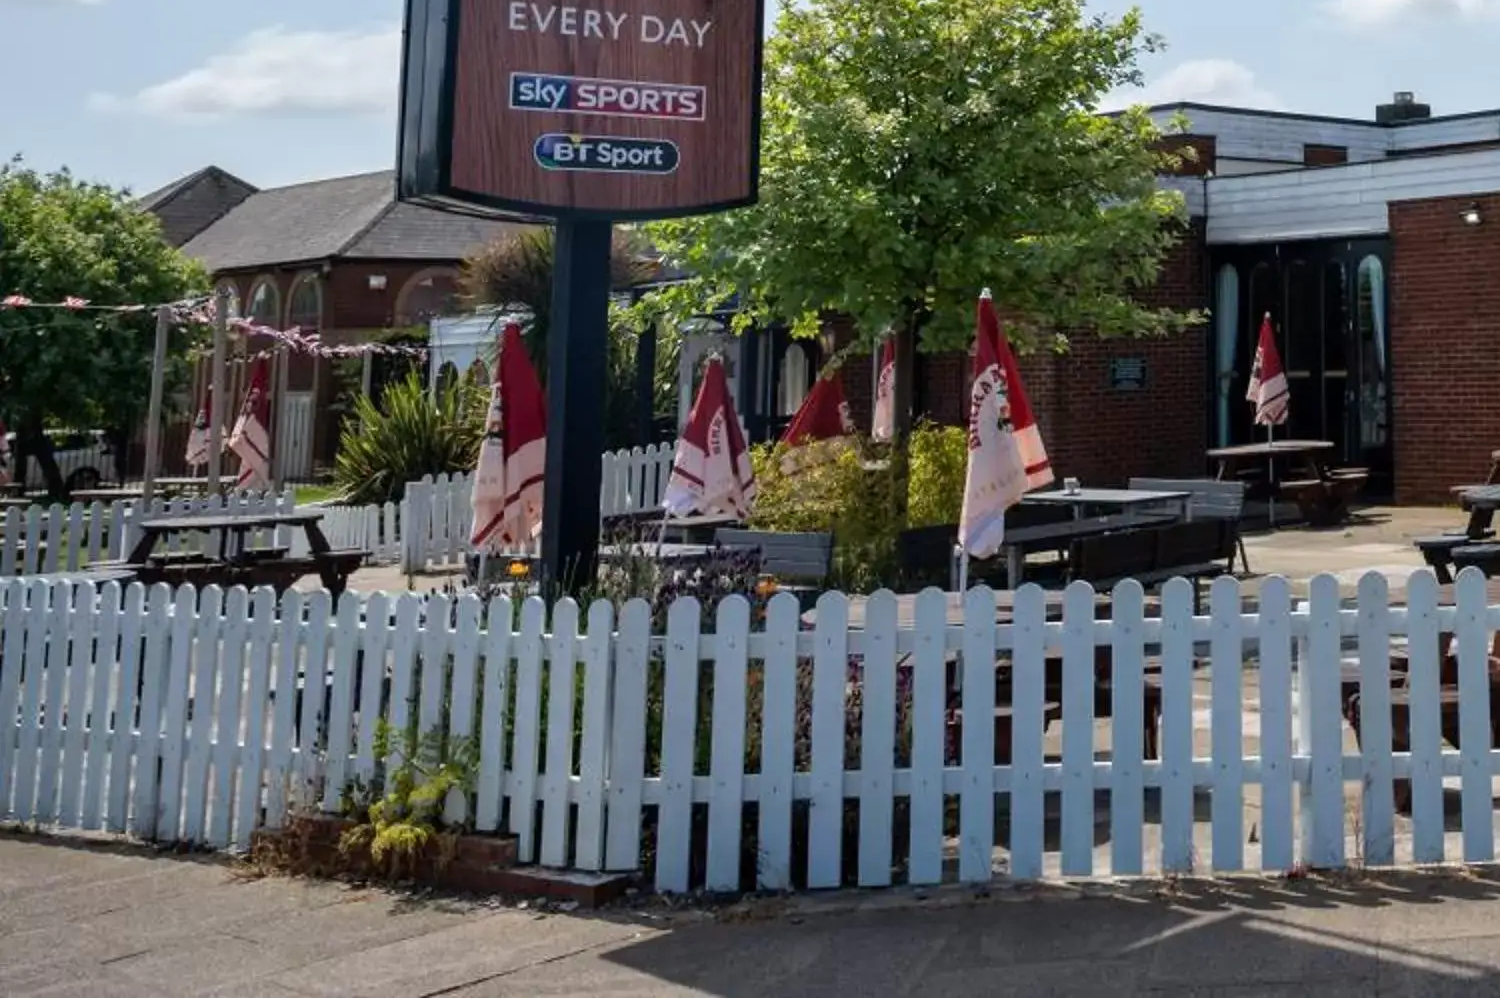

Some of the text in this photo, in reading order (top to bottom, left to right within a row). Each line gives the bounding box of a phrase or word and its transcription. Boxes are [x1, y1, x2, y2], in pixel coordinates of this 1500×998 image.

[508, 1, 713, 49] EVERY DAY
[518, 77, 698, 114] sky SPORTS
[552, 142, 663, 168] BT Sport
